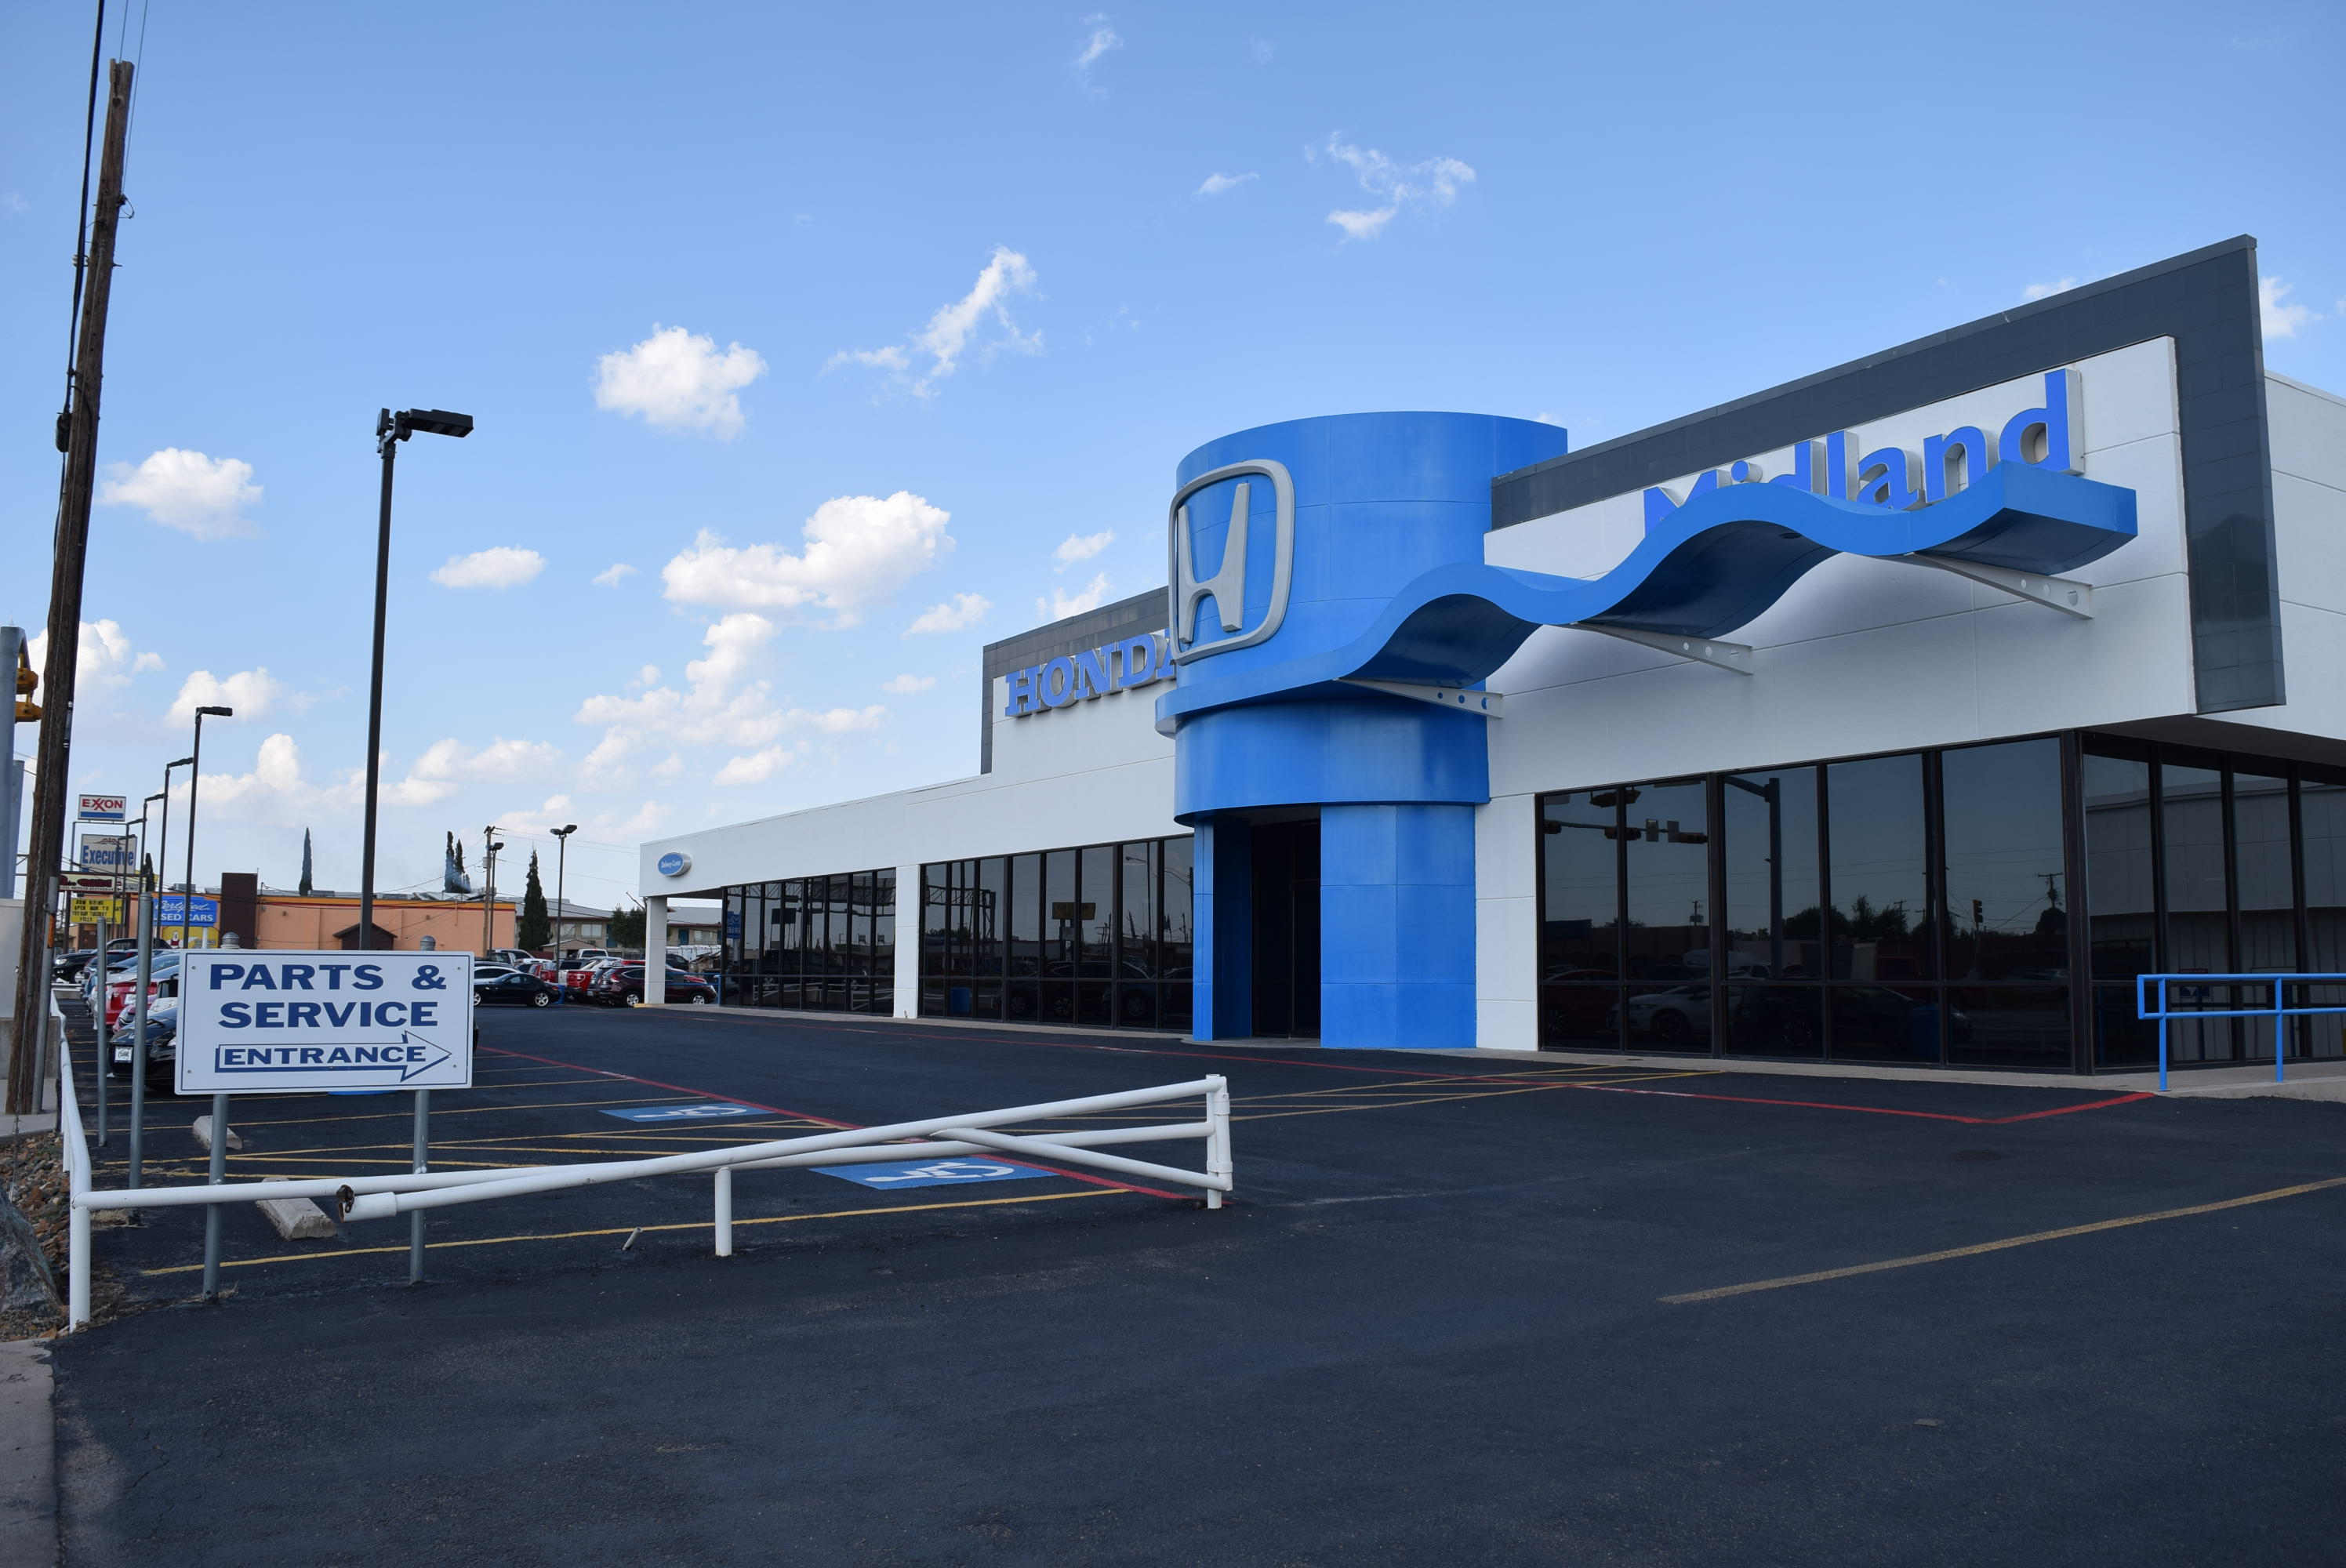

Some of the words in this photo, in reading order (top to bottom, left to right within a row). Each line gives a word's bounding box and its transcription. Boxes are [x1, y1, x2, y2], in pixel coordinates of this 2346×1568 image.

[1643, 368, 2082, 538] Mdland
[82, 798, 123, 811] EXXON
[209, 964, 384, 990] PARTS
[411, 964, 446, 990] &
[218, 1001, 438, 1029] SERVICE
[224, 1046, 427, 1065] ENTRANCE
